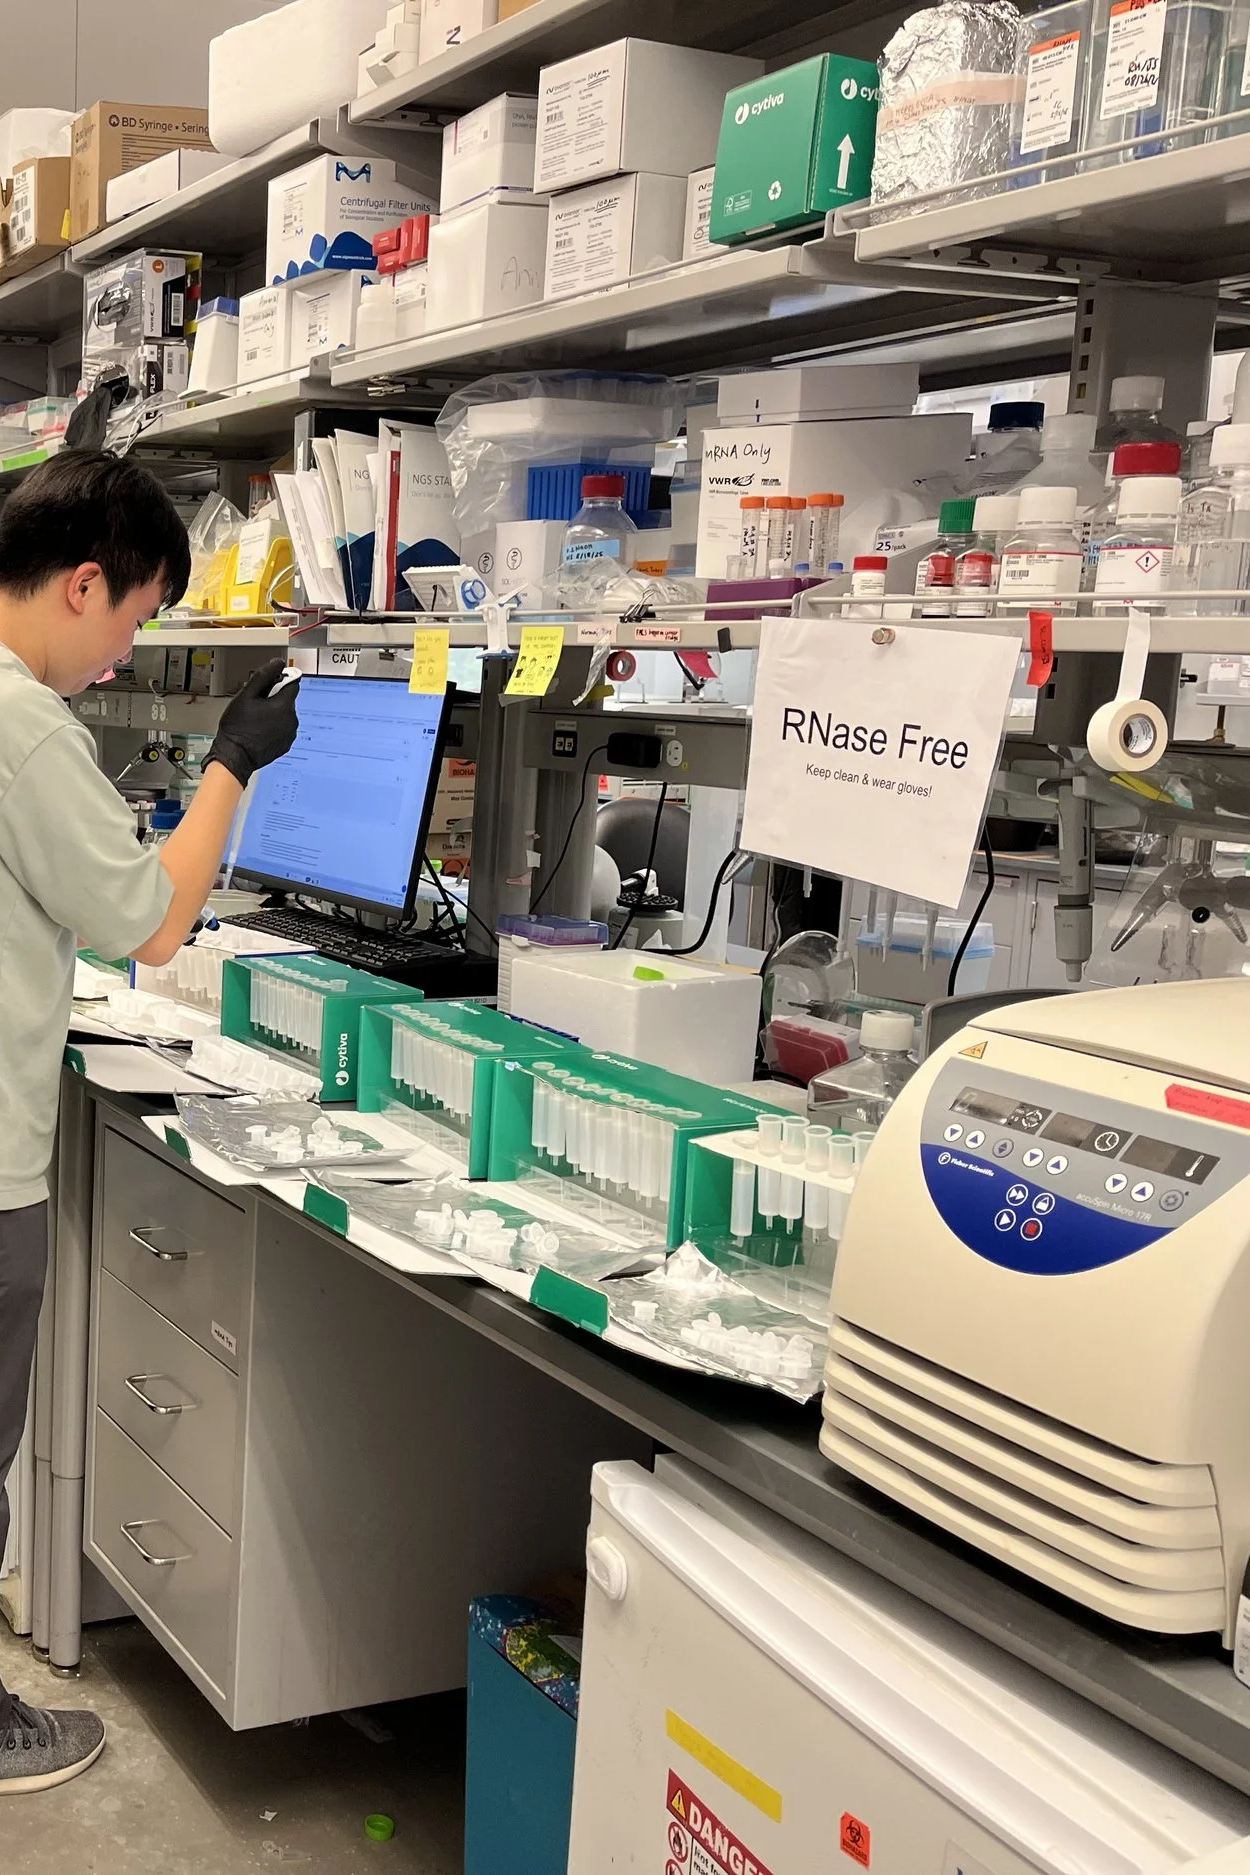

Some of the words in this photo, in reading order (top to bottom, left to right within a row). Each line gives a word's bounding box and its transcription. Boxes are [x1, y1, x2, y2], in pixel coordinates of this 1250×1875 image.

[751, 92, 785, 115] cytiva
[121, 116, 137, 128] BD
[139, 118, 173, 132] Syringe
[340, 196, 386, 209] Centrifugal
[388, 199, 408, 210] Filter
[410, 202, 431, 212] Units
[743, 443, 771, 464] Only
[412, 474, 431, 485] NGS
[708, 477, 731, 485] VWR
[782, 707, 888, 755] RNase
[898, 723, 969, 769] Free
[806, 763, 831, 780] Keep
[833, 769, 860, 785] clean
[862, 773, 869, 785] &
[872, 777, 896, 791] wear
[897, 781, 933, 798] gloves!
[338, 1033, 349, 1068] cytiva
[950, 1157, 969, 1169] Fisher
[968, 1162, 995, 1177] Scientific
[1075, 1192, 1110, 1210] accuSpin
[1111, 1203, 1135, 1217] Micro
[1136, 1210, 1153, 1222] 17R
[689, 1801, 763, 1875] DANGE
